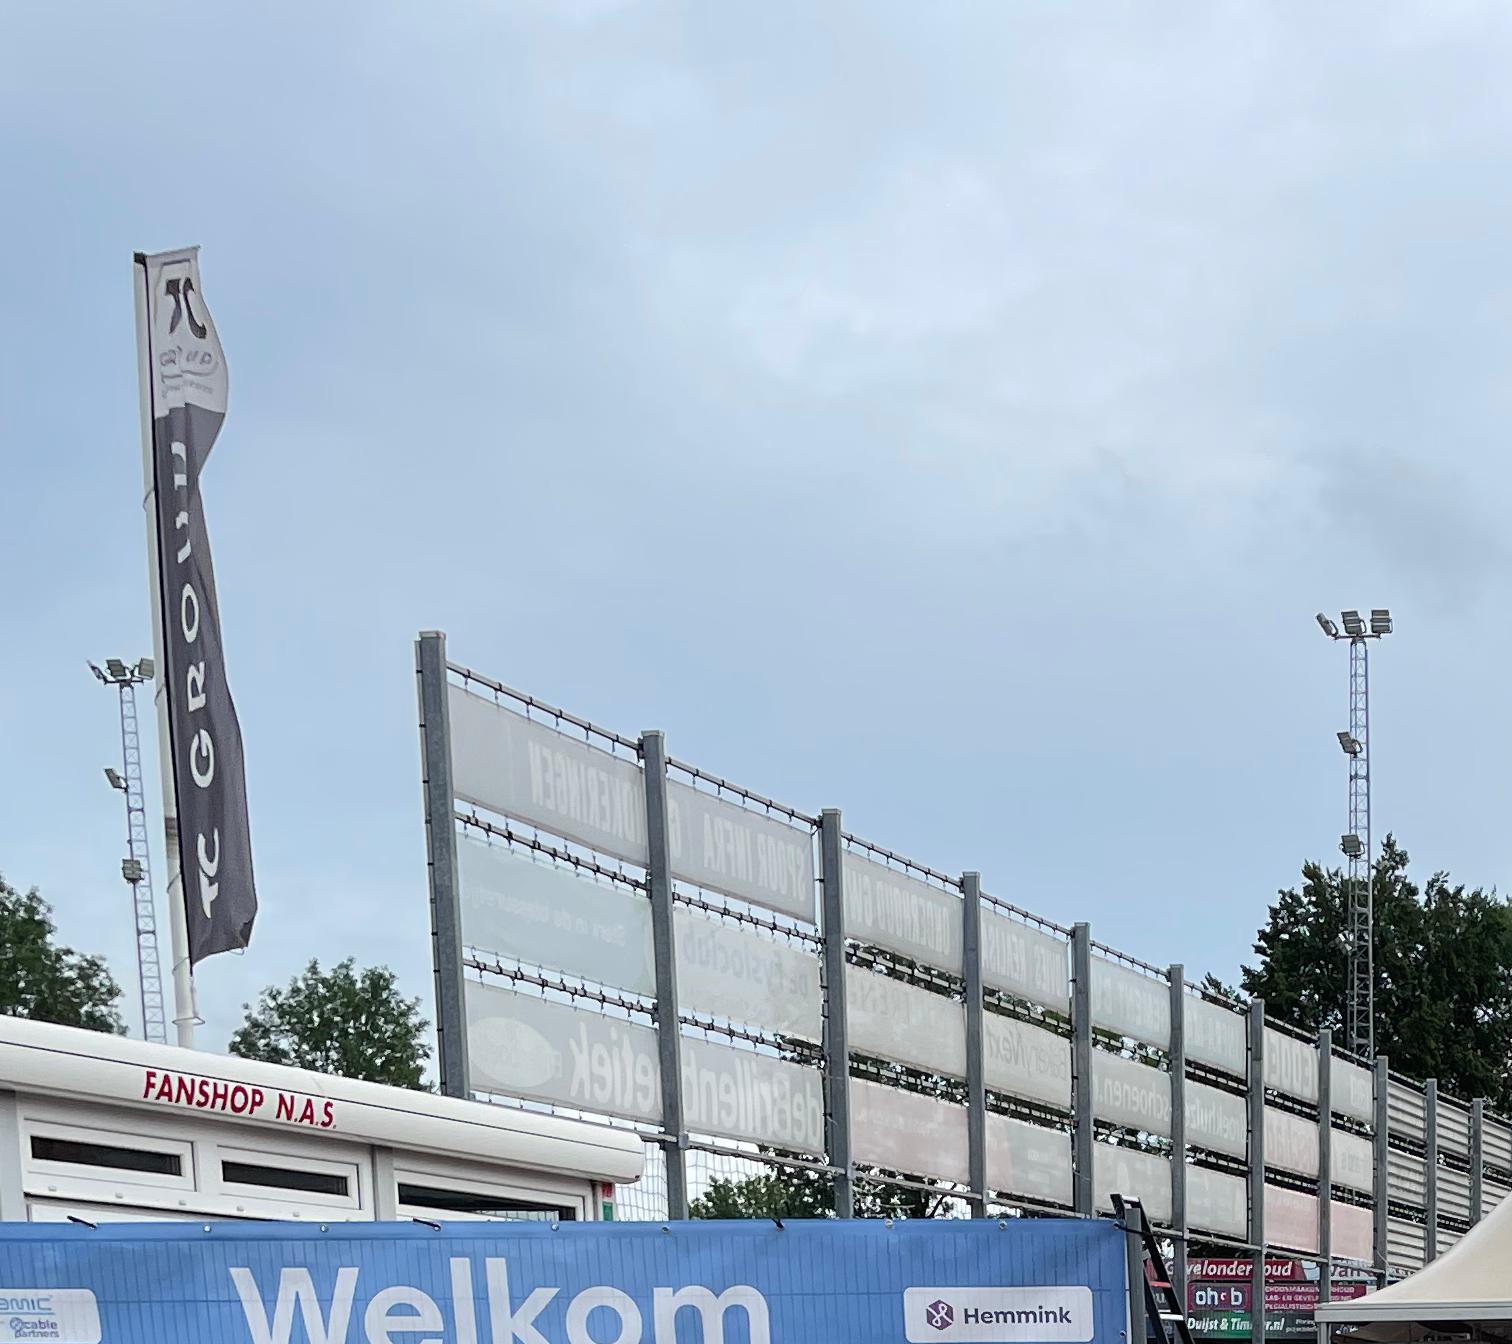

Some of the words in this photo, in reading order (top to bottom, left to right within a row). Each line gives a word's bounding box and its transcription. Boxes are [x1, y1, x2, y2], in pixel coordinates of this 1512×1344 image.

[143, 1071, 264, 1115] FANSHOP
[275, 1093, 337, 1129] N.A.S.
[1165, 1260, 1292, 1277] Gvelonderoud
[963, 1305, 1072, 1325] Hemmink
[24, 1320, 58, 1330] cable
[1220, 1318, 1229, 1330] &
[1230, 1317, 1285, 1331] Timr.nl
[15, 1329, 60, 1339] partners
